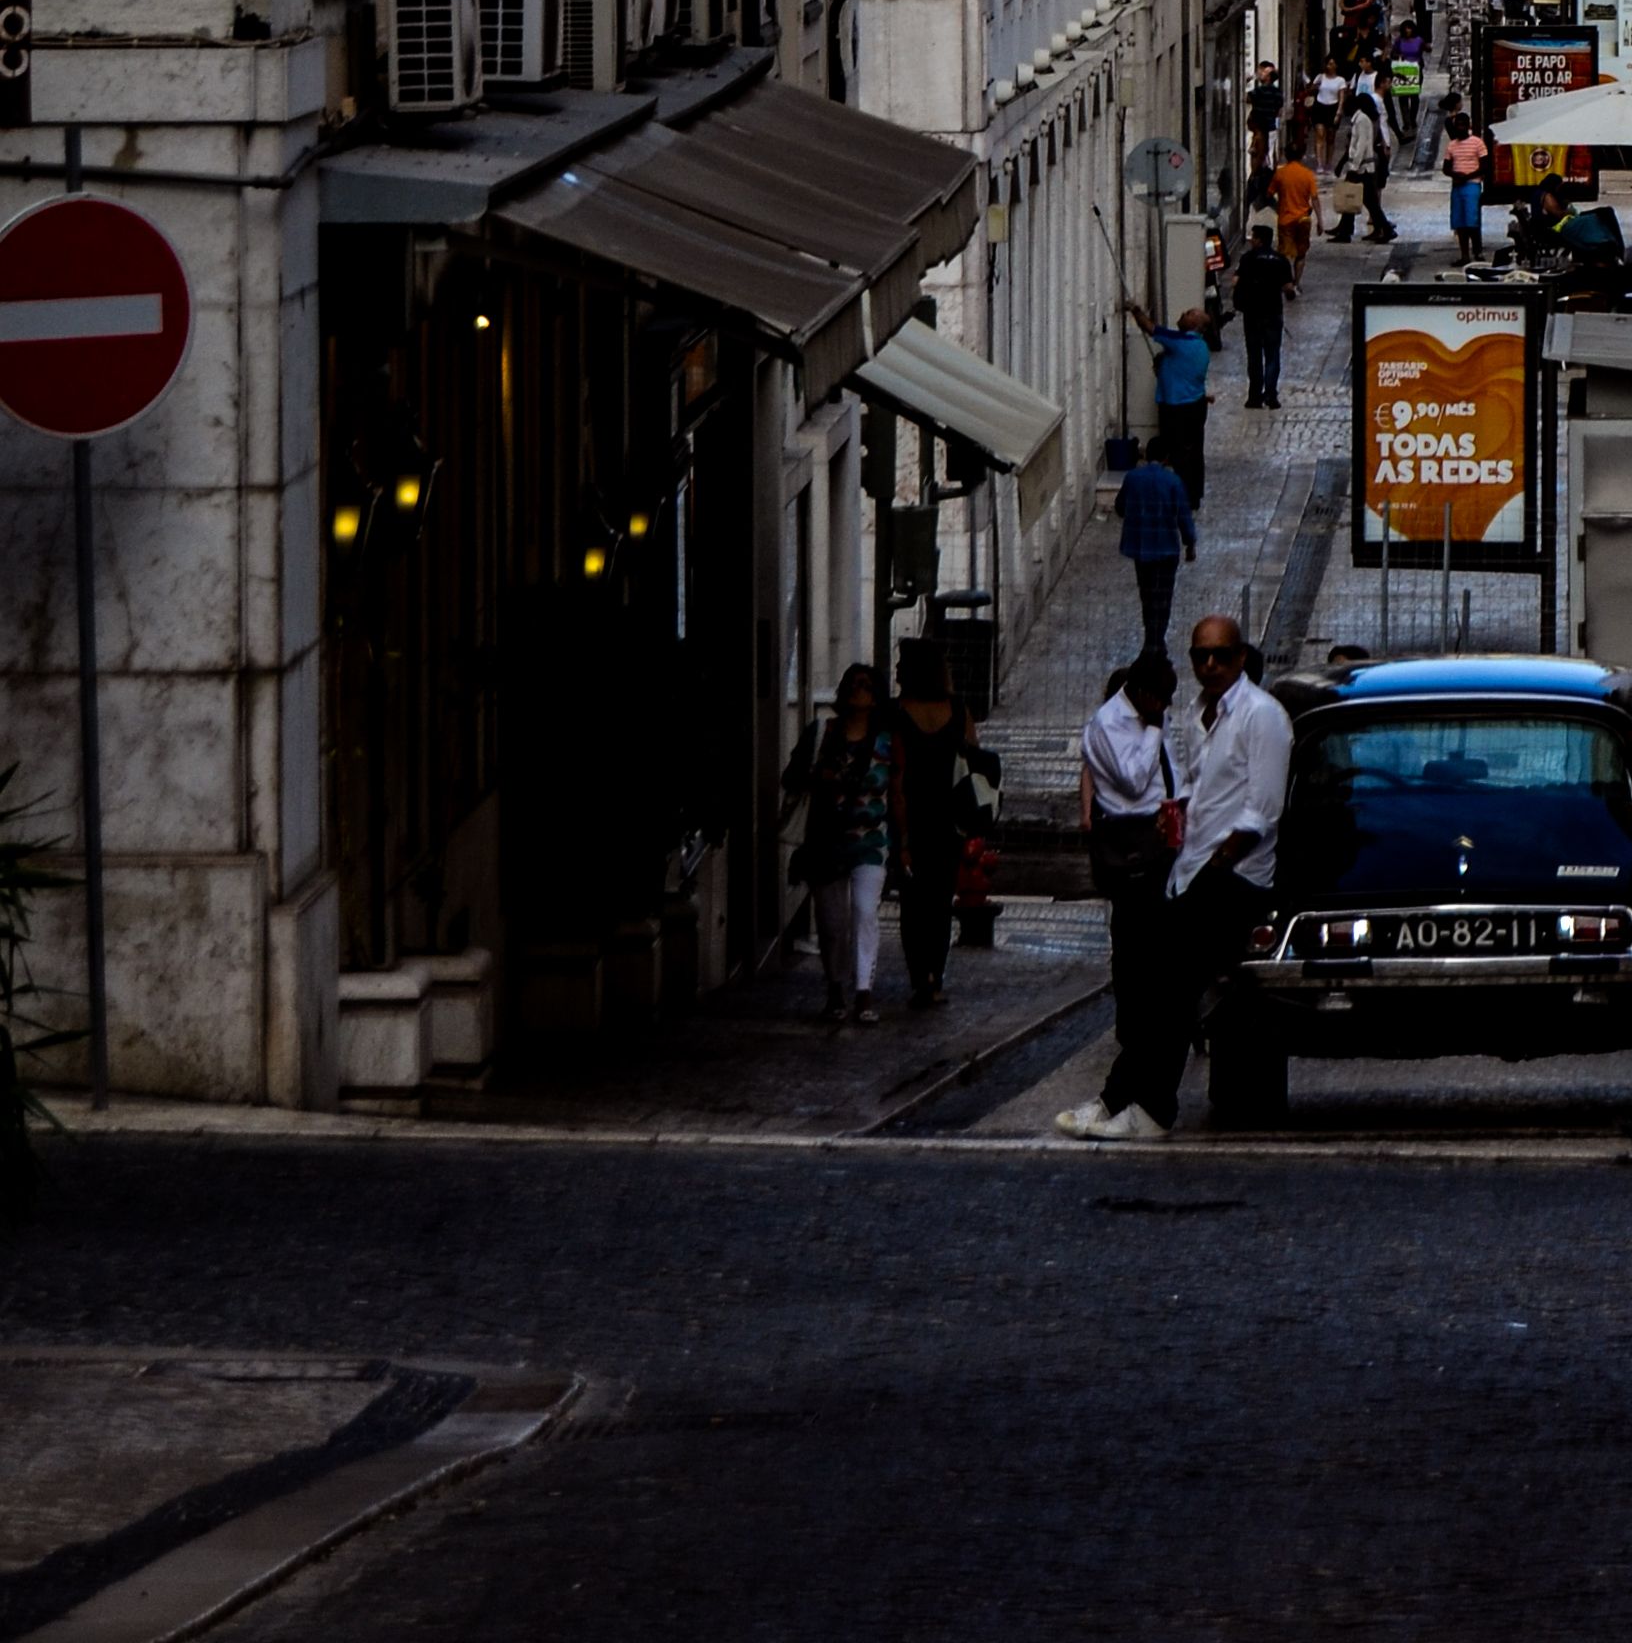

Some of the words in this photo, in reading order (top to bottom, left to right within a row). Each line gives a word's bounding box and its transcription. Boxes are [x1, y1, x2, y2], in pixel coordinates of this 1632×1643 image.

[1517, 55, 1532, 69] DE
[1535, 55, 1566, 69] PAPO
[1511, 71, 1541, 84] PARA
[1544, 71, 1554, 84] O
[1556, 71, 1572, 84] AR
[1518, 85, 1526, 100] É
[1456, 308, 1519, 324] optimus
[1375, 433, 1476, 457] TODAS
[1374, 460, 1415, 484] AS
[1420, 460, 1514, 484] REDES
[1396, 920, 1537, 950] AO-82-11
